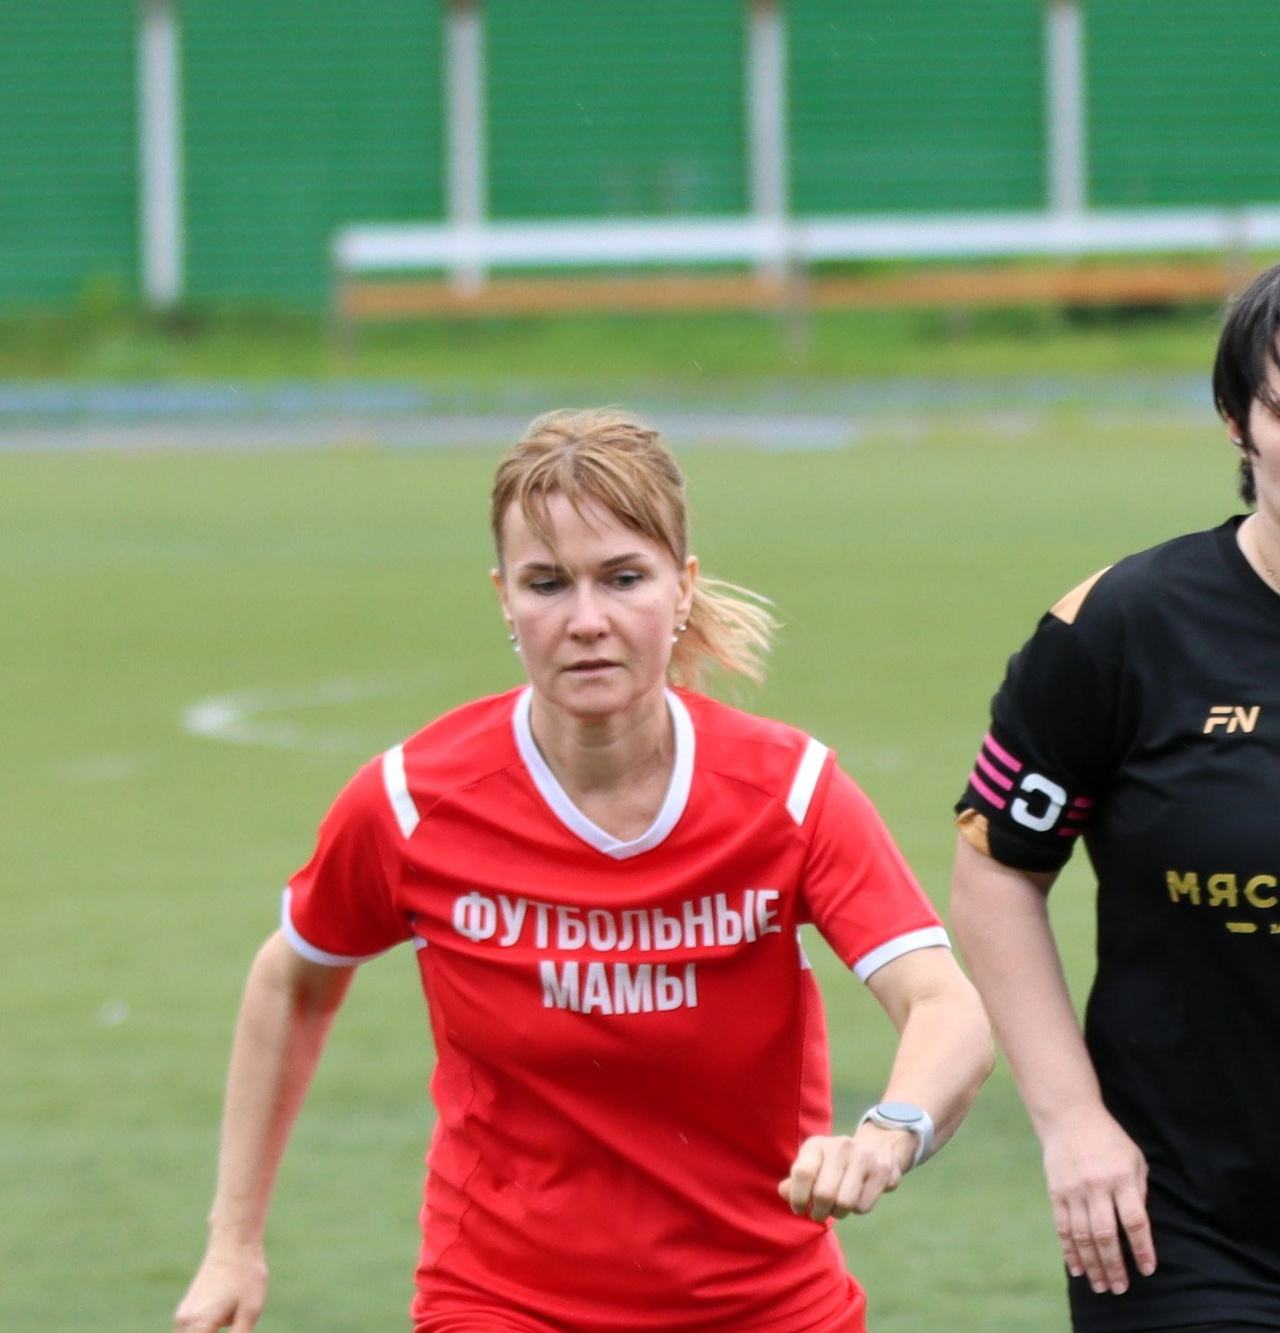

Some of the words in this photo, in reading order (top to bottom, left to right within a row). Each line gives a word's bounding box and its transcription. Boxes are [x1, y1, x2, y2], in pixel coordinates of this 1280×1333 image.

[1203, 706, 1260, 733] FN
[452, 889, 782, 952] ФУТБОЛЬНЫЕ
[539, 960, 698, 1016] МАМЫ
